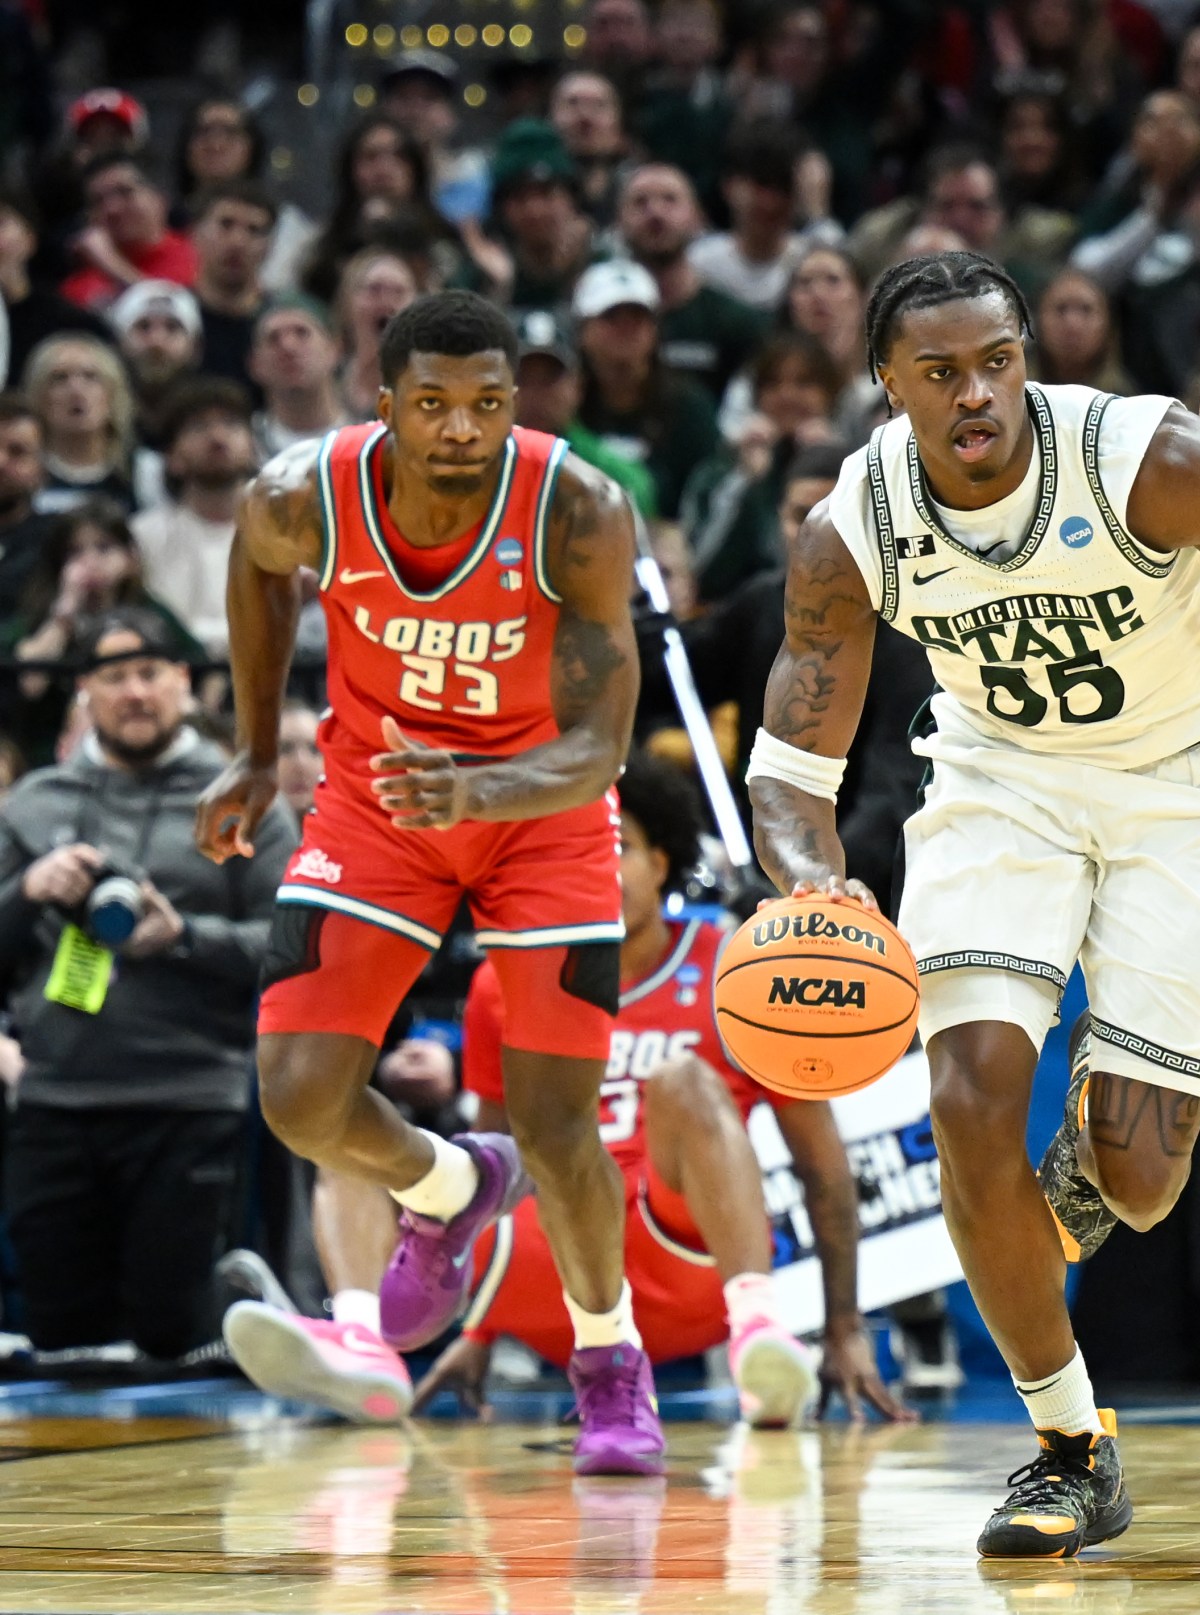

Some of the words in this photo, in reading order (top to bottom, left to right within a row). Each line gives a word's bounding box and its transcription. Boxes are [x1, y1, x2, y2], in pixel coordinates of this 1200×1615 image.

[904, 538, 925, 558] JF
[1066, 530, 1092, 545] NCAA
[354, 605, 527, 662] LOBOS
[911, 585, 1146, 663] STATE
[956, 595, 1088, 632] MICHIGAN
[399, 654, 498, 716] 23
[753, 912, 886, 956] Wilson
[766, 1007, 807, 1015] OFFICIAL
[768, 976, 866, 1009] NCAA
[605, 1029, 701, 1079] BOS
[598, 1079, 638, 1146] 3
